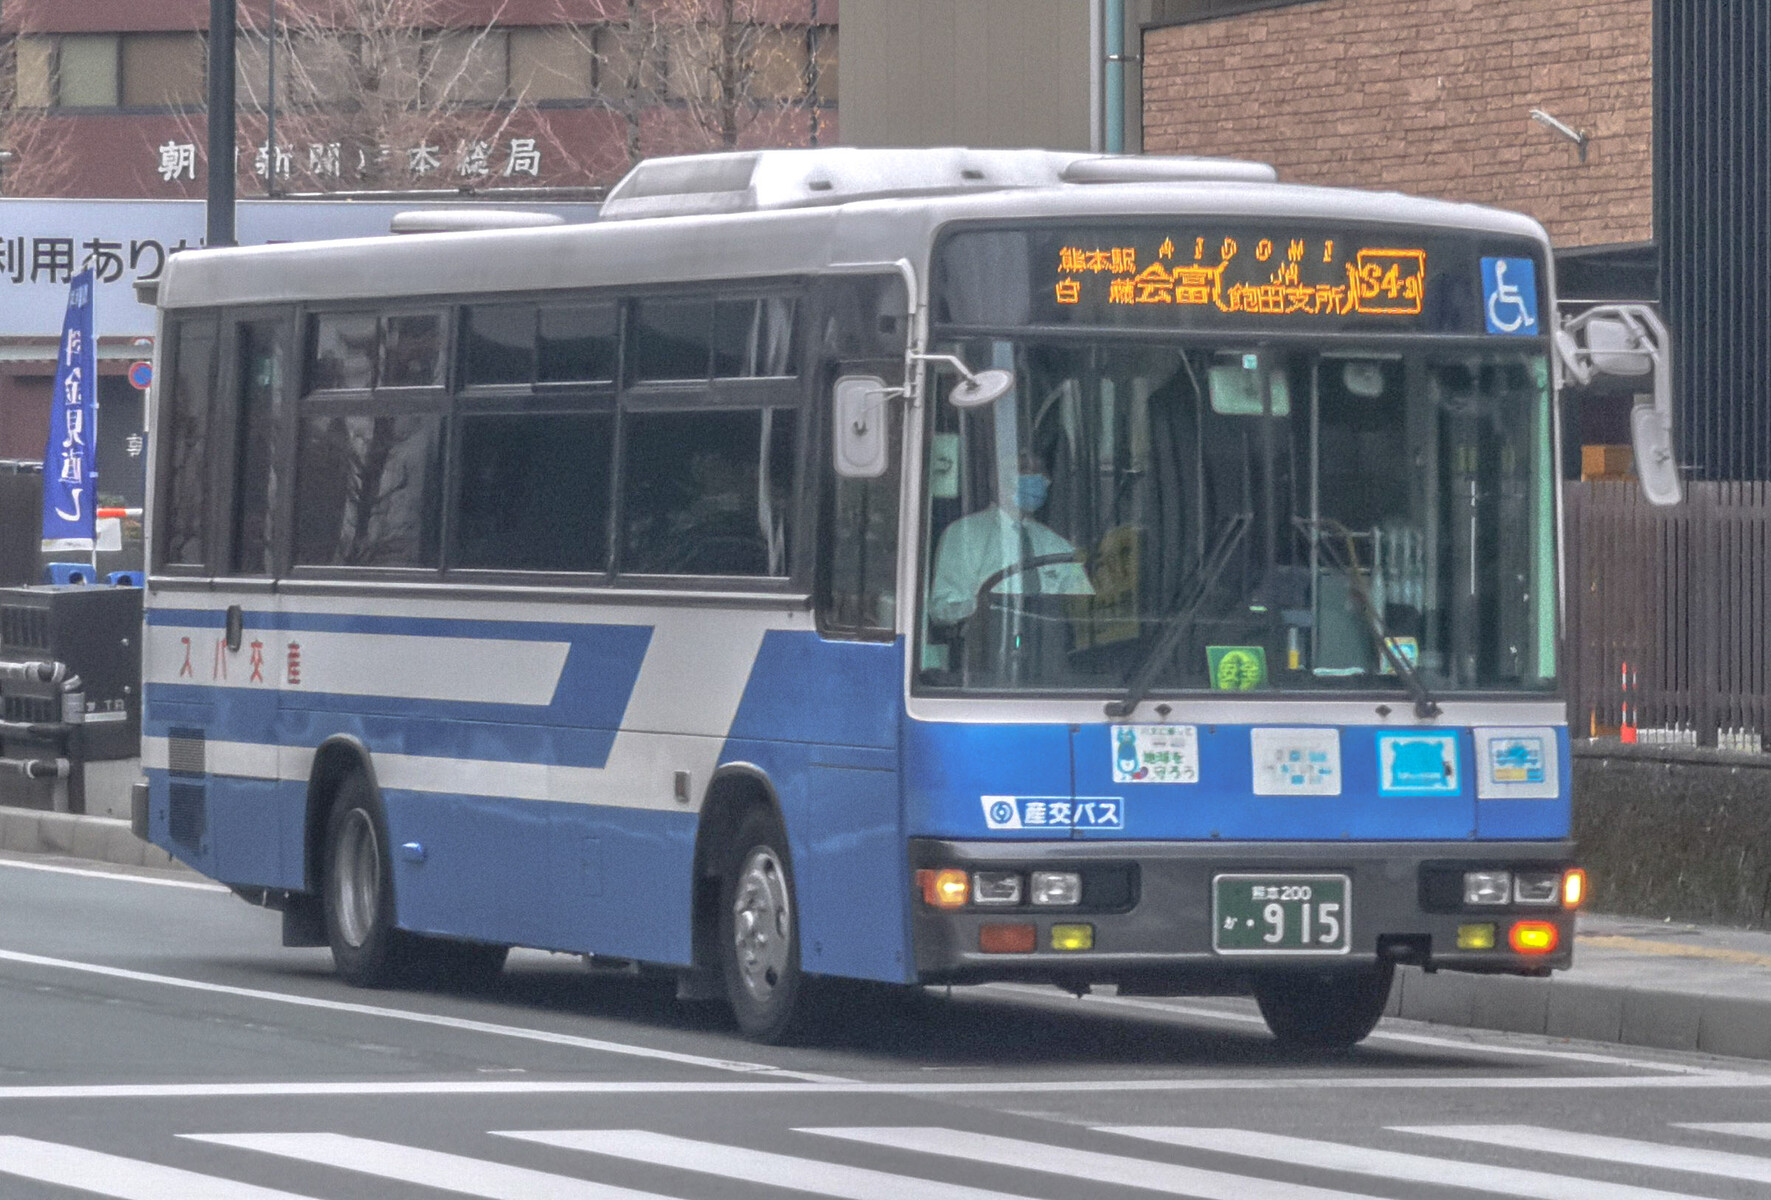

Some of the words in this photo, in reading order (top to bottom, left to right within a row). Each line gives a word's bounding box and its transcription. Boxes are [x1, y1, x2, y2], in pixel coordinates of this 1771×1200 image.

[0, 236, 206, 284] 利用あり
[1057, 247, 1136, 274] 熊本駅
[1024, 802, 1119, 824] 産交バス
